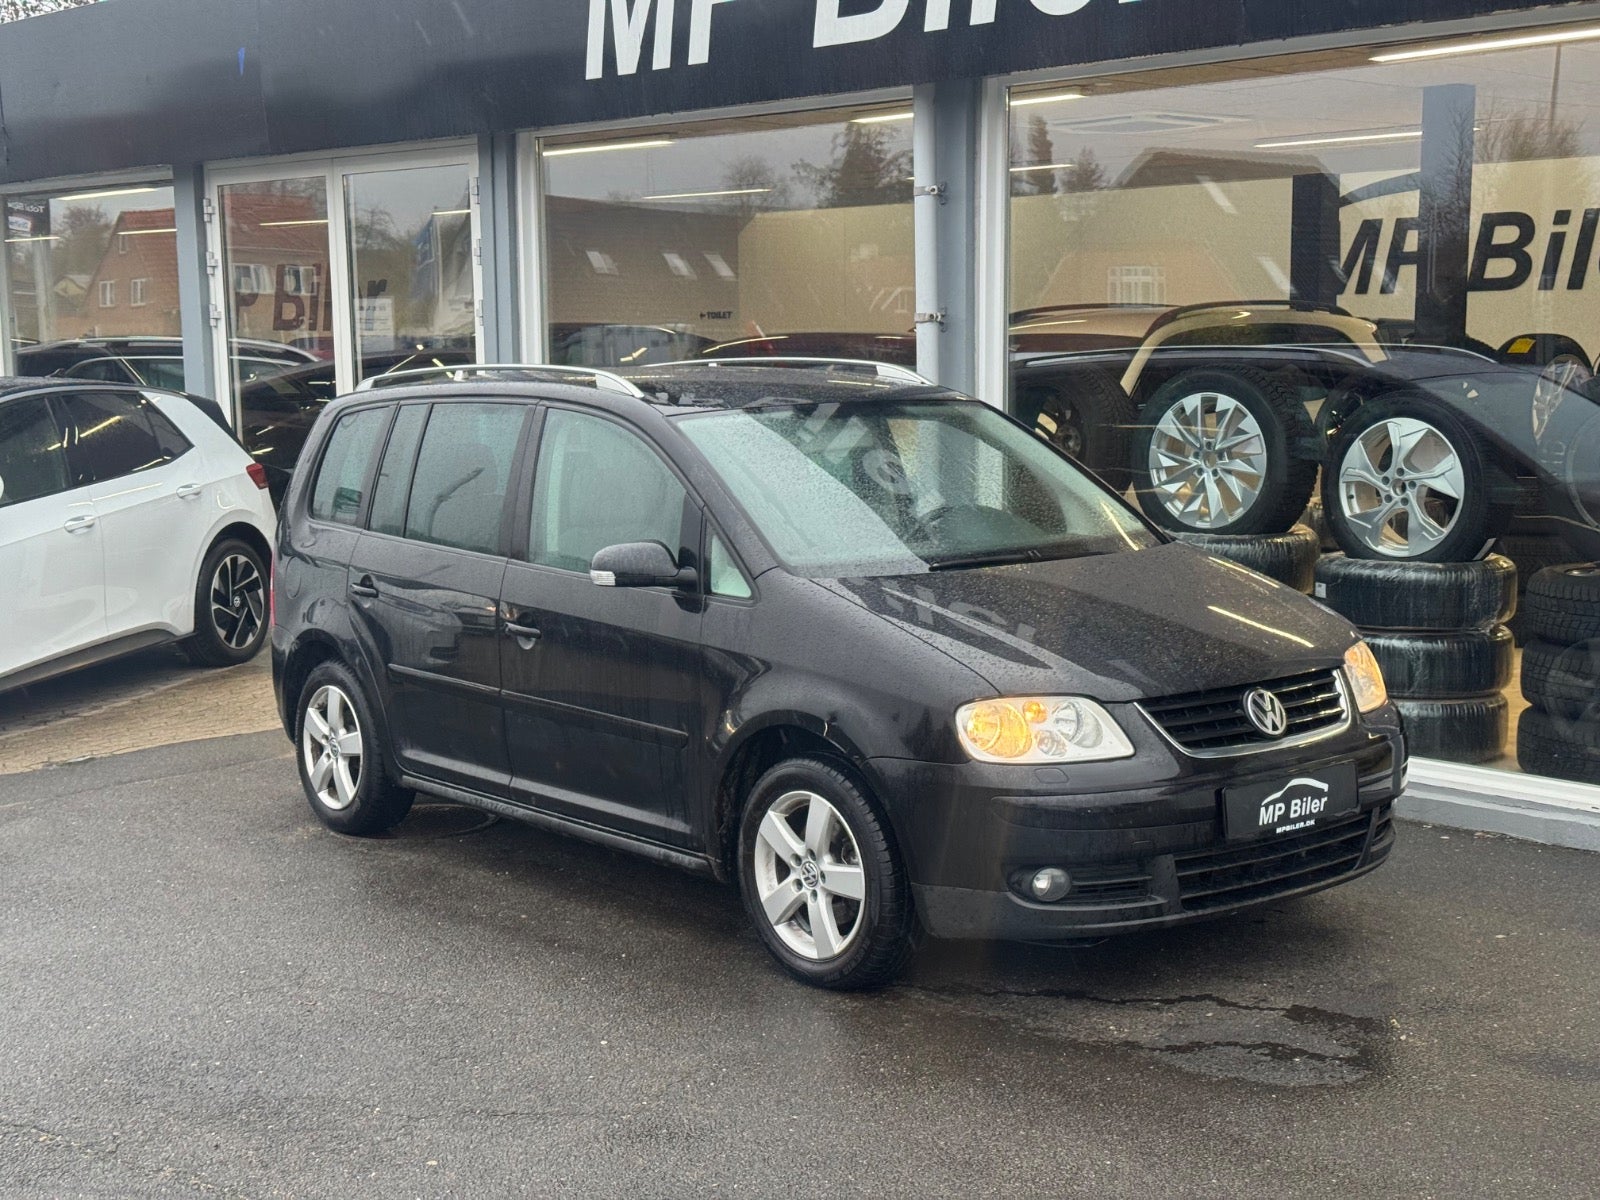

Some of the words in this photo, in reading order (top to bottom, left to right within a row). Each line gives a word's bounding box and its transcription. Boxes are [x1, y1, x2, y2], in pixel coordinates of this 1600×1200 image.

[1466, 207, 1600, 292] Bil
[706, 311, 733, 320] TOILET
[1258, 802, 1286, 826] MP
[1289, 796, 1328, 819] Biler
